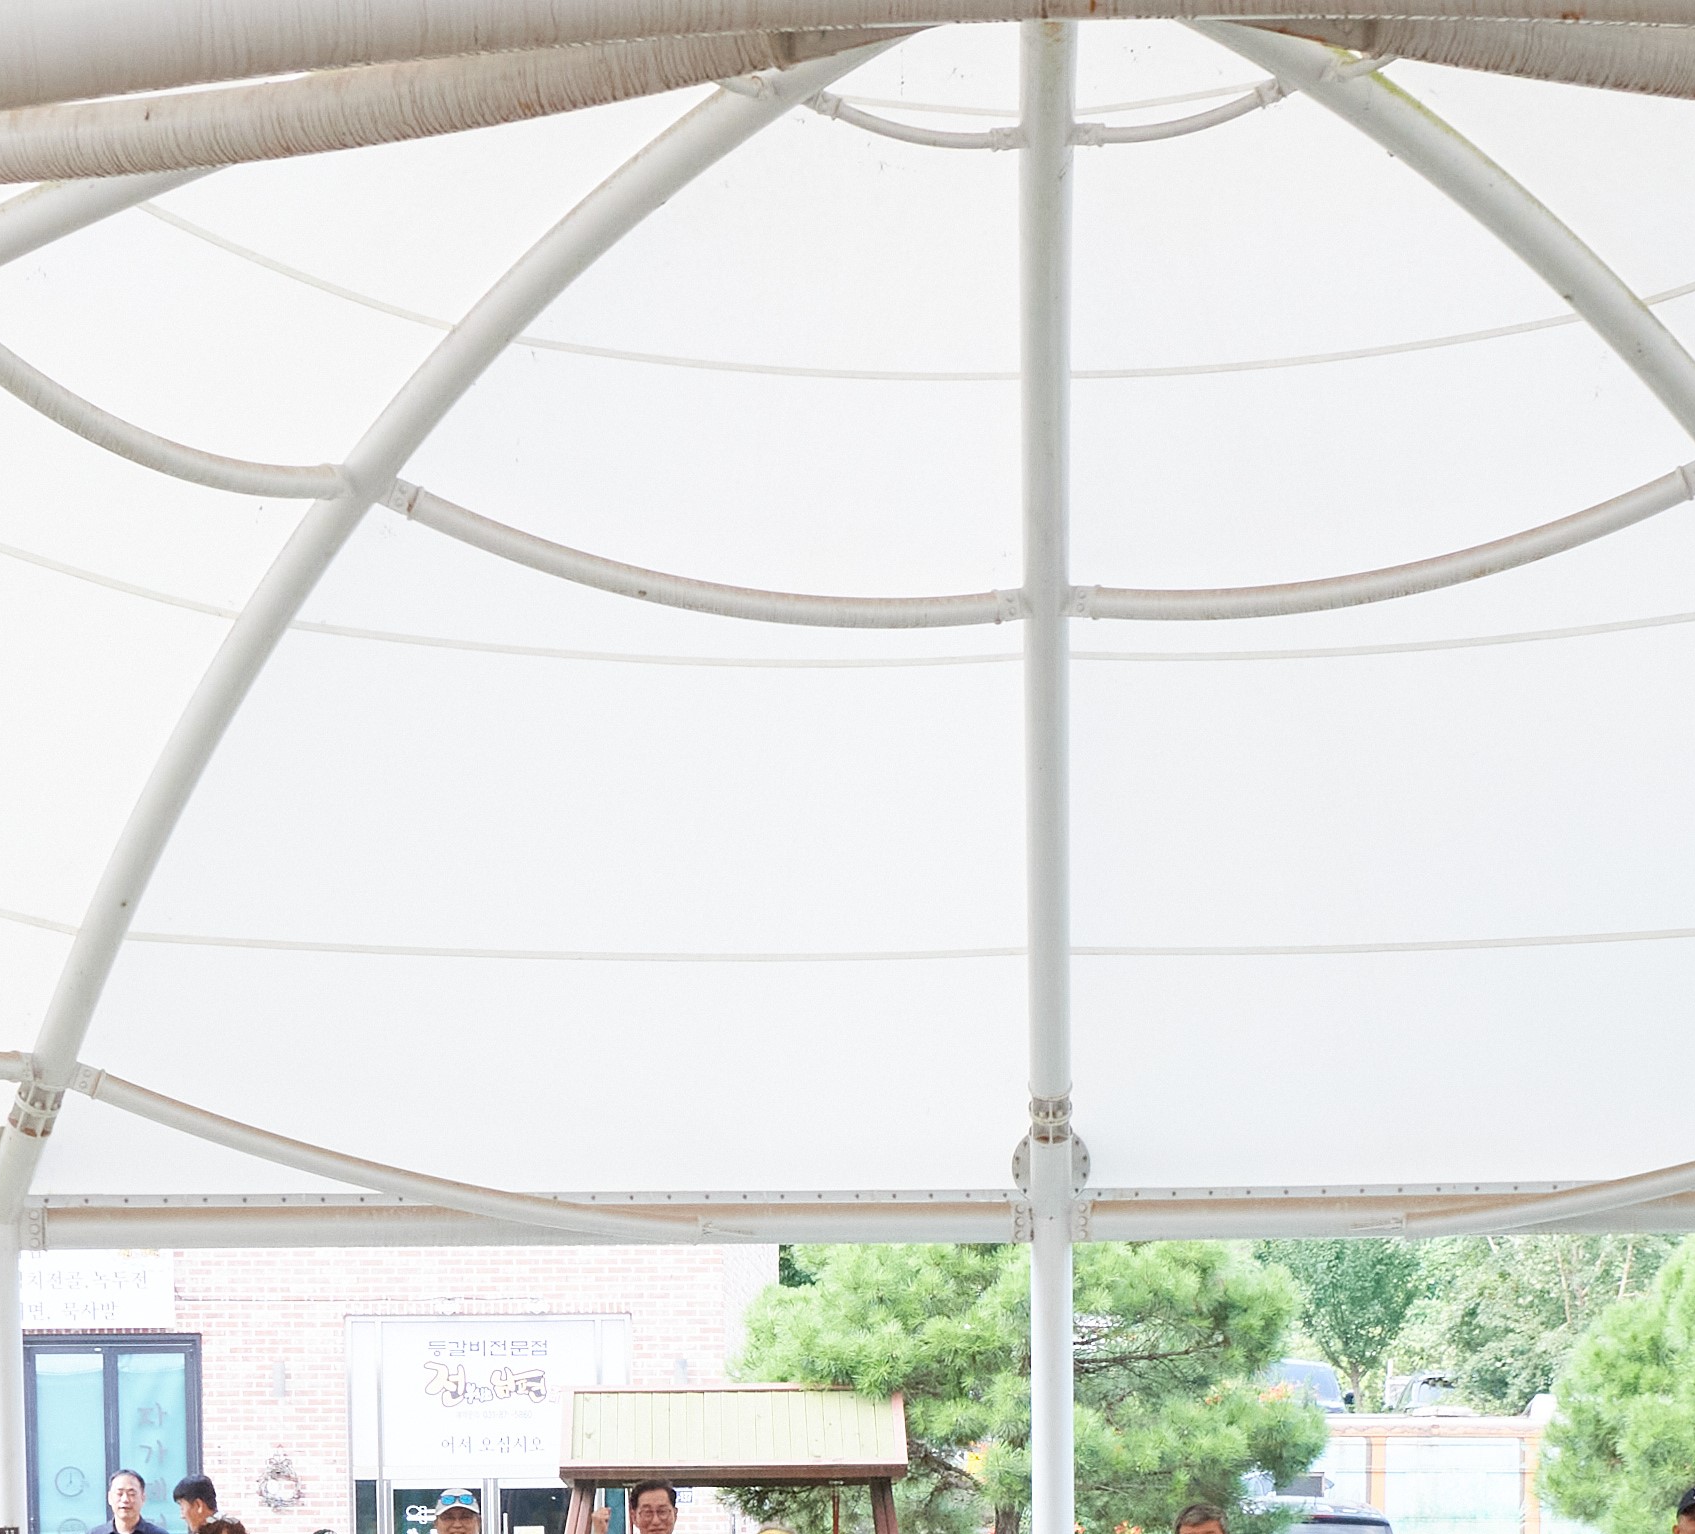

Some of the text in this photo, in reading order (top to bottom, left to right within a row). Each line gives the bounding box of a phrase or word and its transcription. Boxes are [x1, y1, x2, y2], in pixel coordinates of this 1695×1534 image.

[428, 1340, 548, 1357] 등갈비전문점
[442, 1436, 545, 1454] 어서 오십시오
